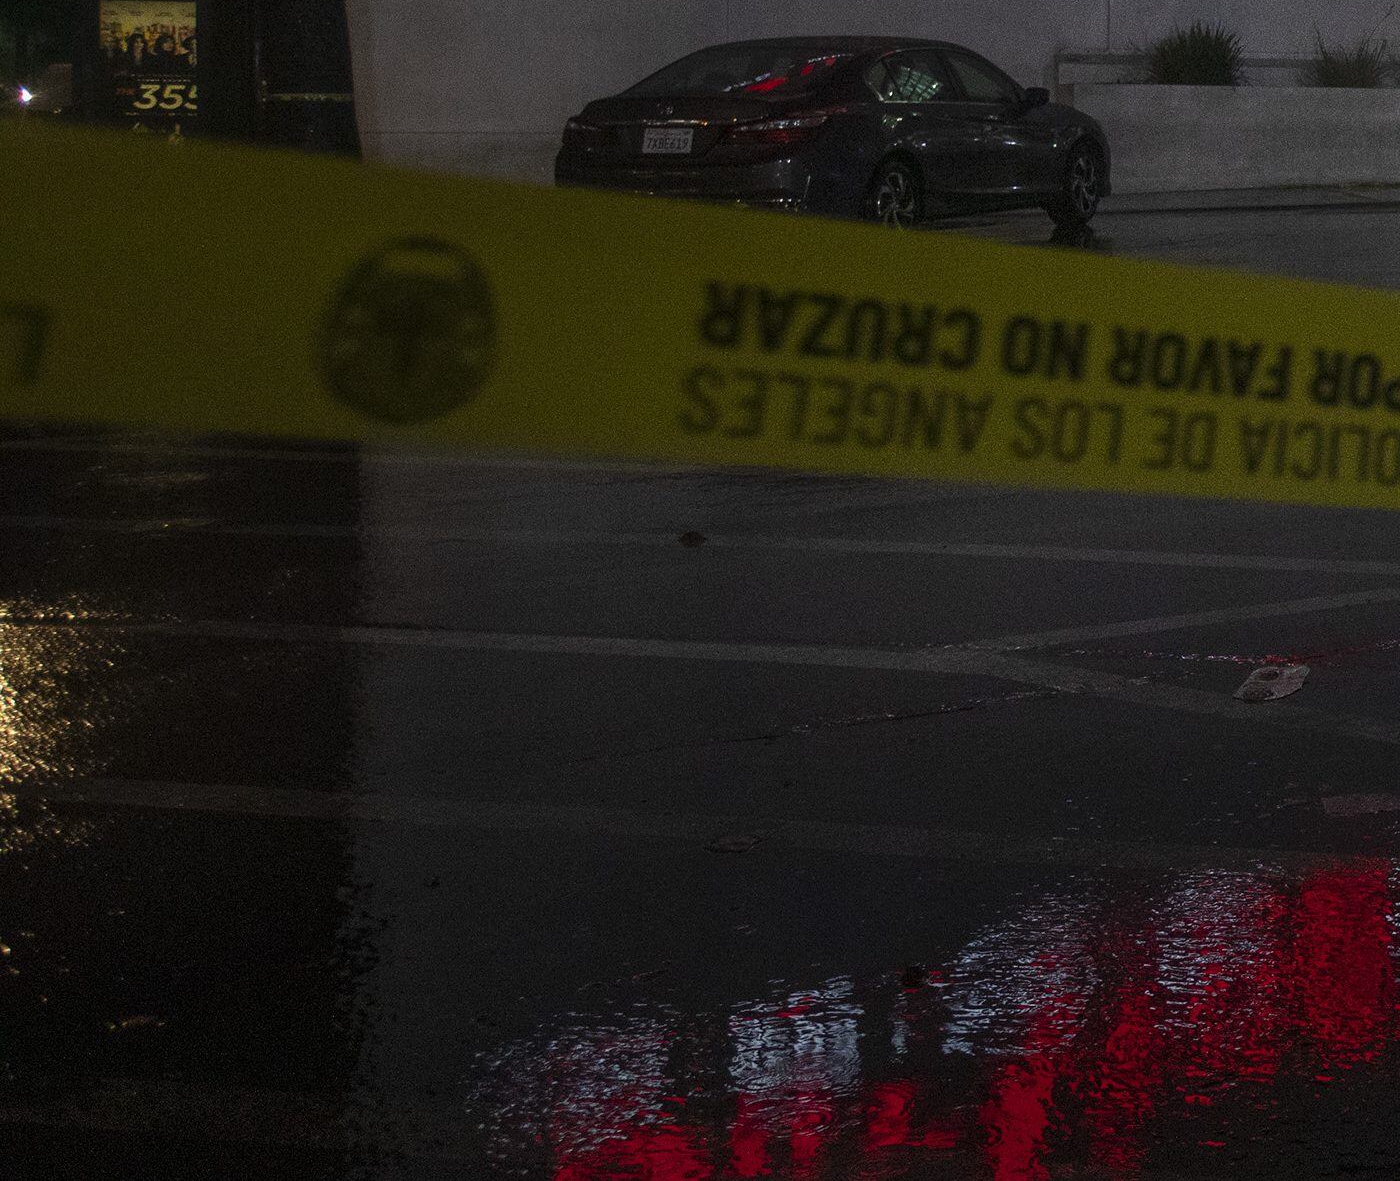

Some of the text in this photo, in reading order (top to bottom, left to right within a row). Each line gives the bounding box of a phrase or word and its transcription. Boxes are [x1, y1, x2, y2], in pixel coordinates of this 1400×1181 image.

[697, 279, 983, 372] CRUZAR
[998, 313, 1091, 382] NO
[1107, 326, 1293, 402] FAVOR
[677, 363, 995, 456] ANGELES
[1008, 395, 1125, 467] LOS
[1143, 405, 1220, 475] DE
